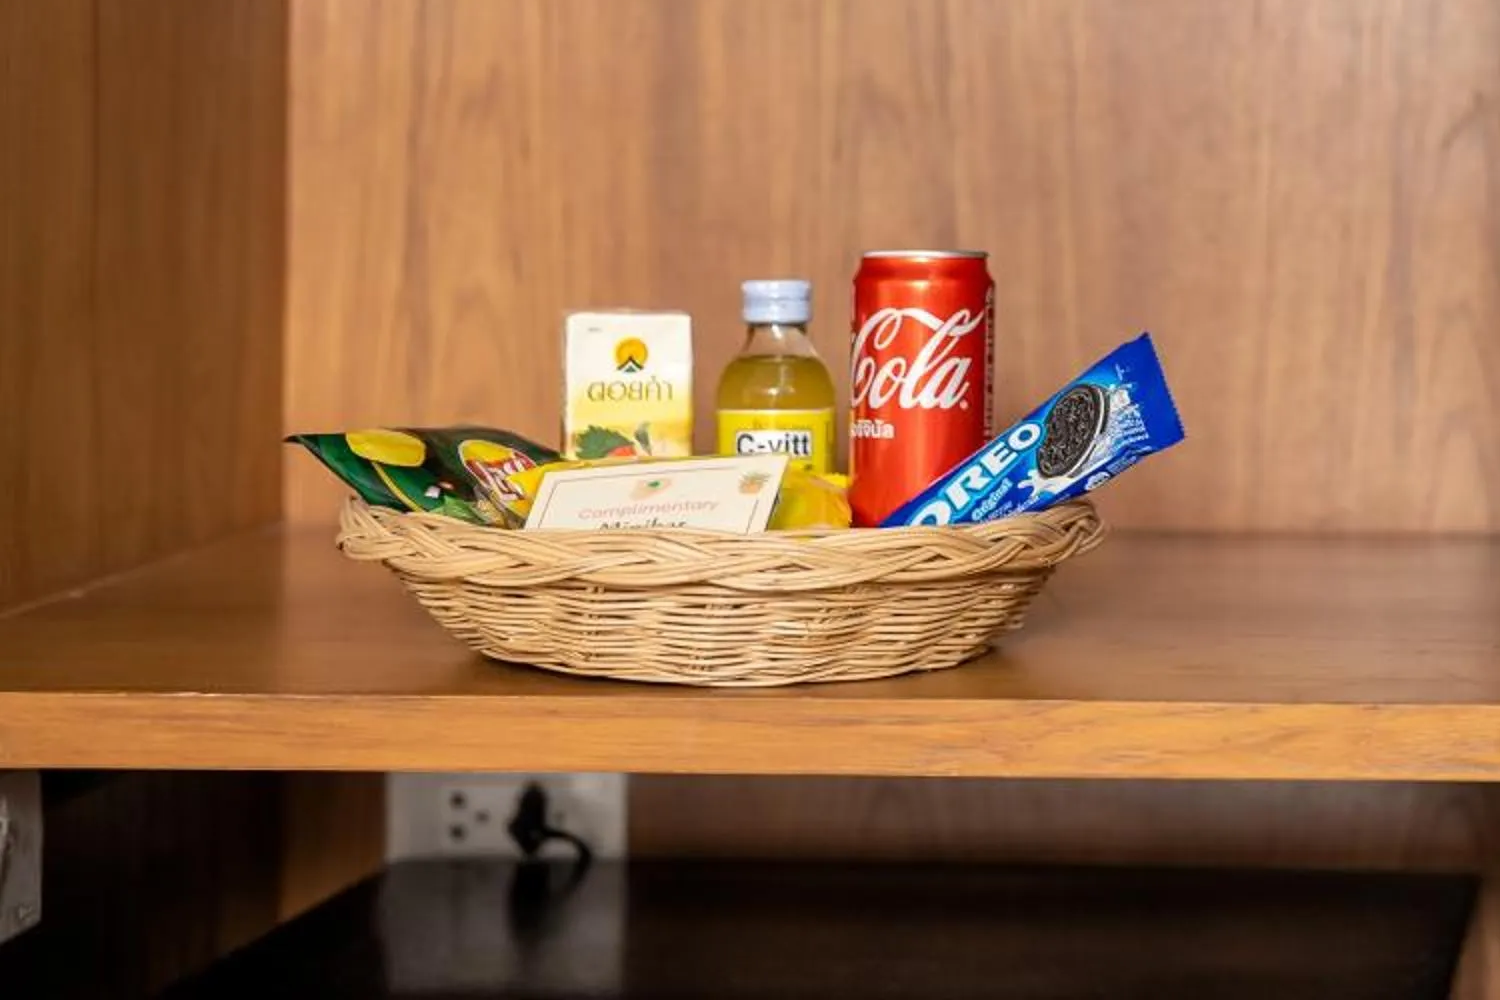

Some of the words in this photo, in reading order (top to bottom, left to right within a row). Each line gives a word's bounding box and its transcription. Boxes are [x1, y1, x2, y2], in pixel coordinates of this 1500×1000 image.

[586, 375, 674, 402] ดอยคำ
[737, 432, 809, 456] C-vitt
[910, 422, 1042, 526] OREO
[577, 499, 719, 521] Complimentary
